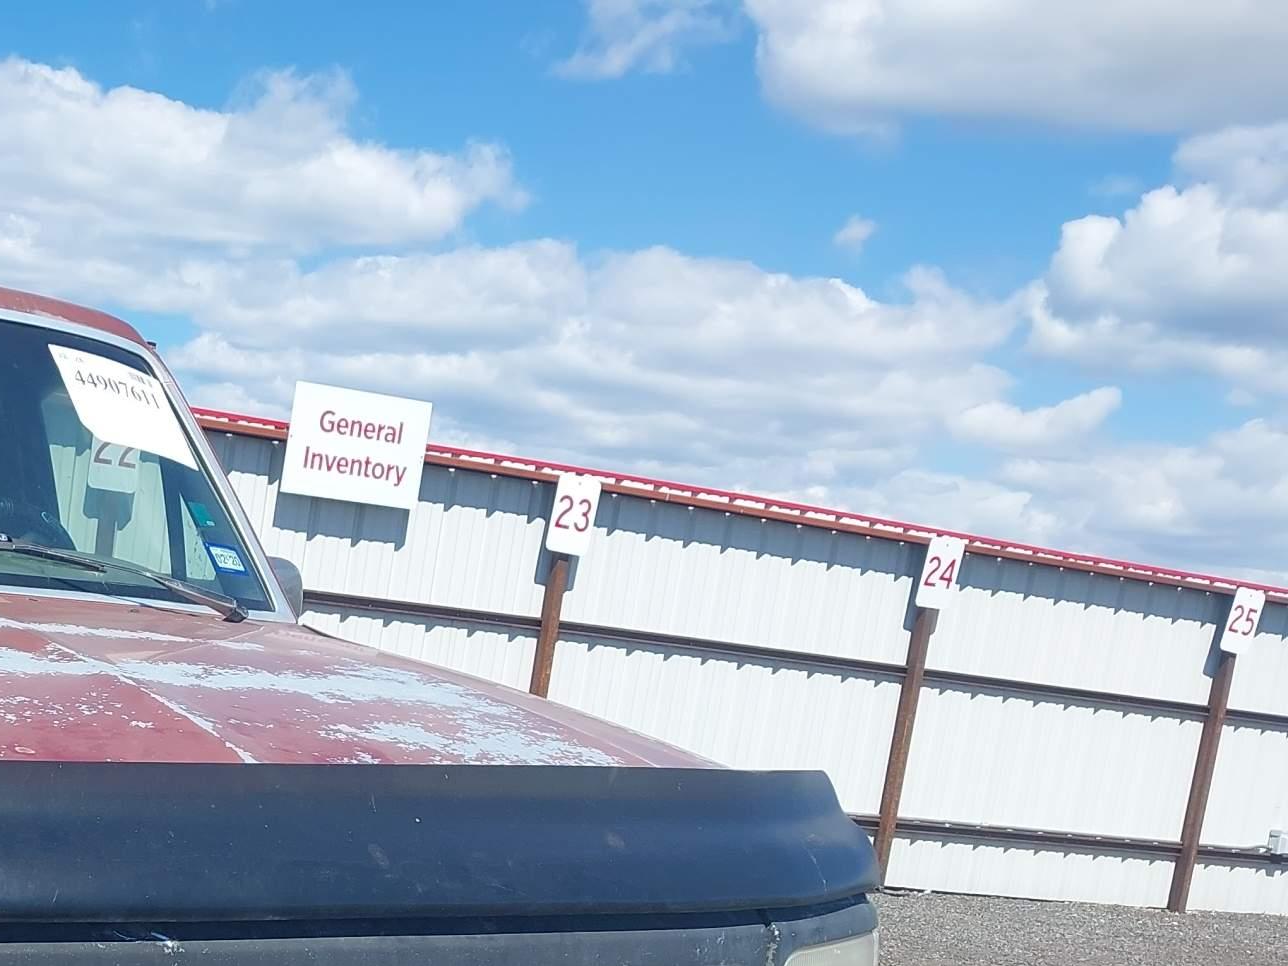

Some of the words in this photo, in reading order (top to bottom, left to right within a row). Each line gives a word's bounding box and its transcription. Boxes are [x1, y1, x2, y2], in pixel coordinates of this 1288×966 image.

[74, 369, 160, 409] 44907611
[319, 410, 404, 445] General
[303, 446, 407, 487] Inventory
[554, 495, 592, 532] 23
[923, 556, 956, 589] 24
[1228, 605, 1258, 636] 25
